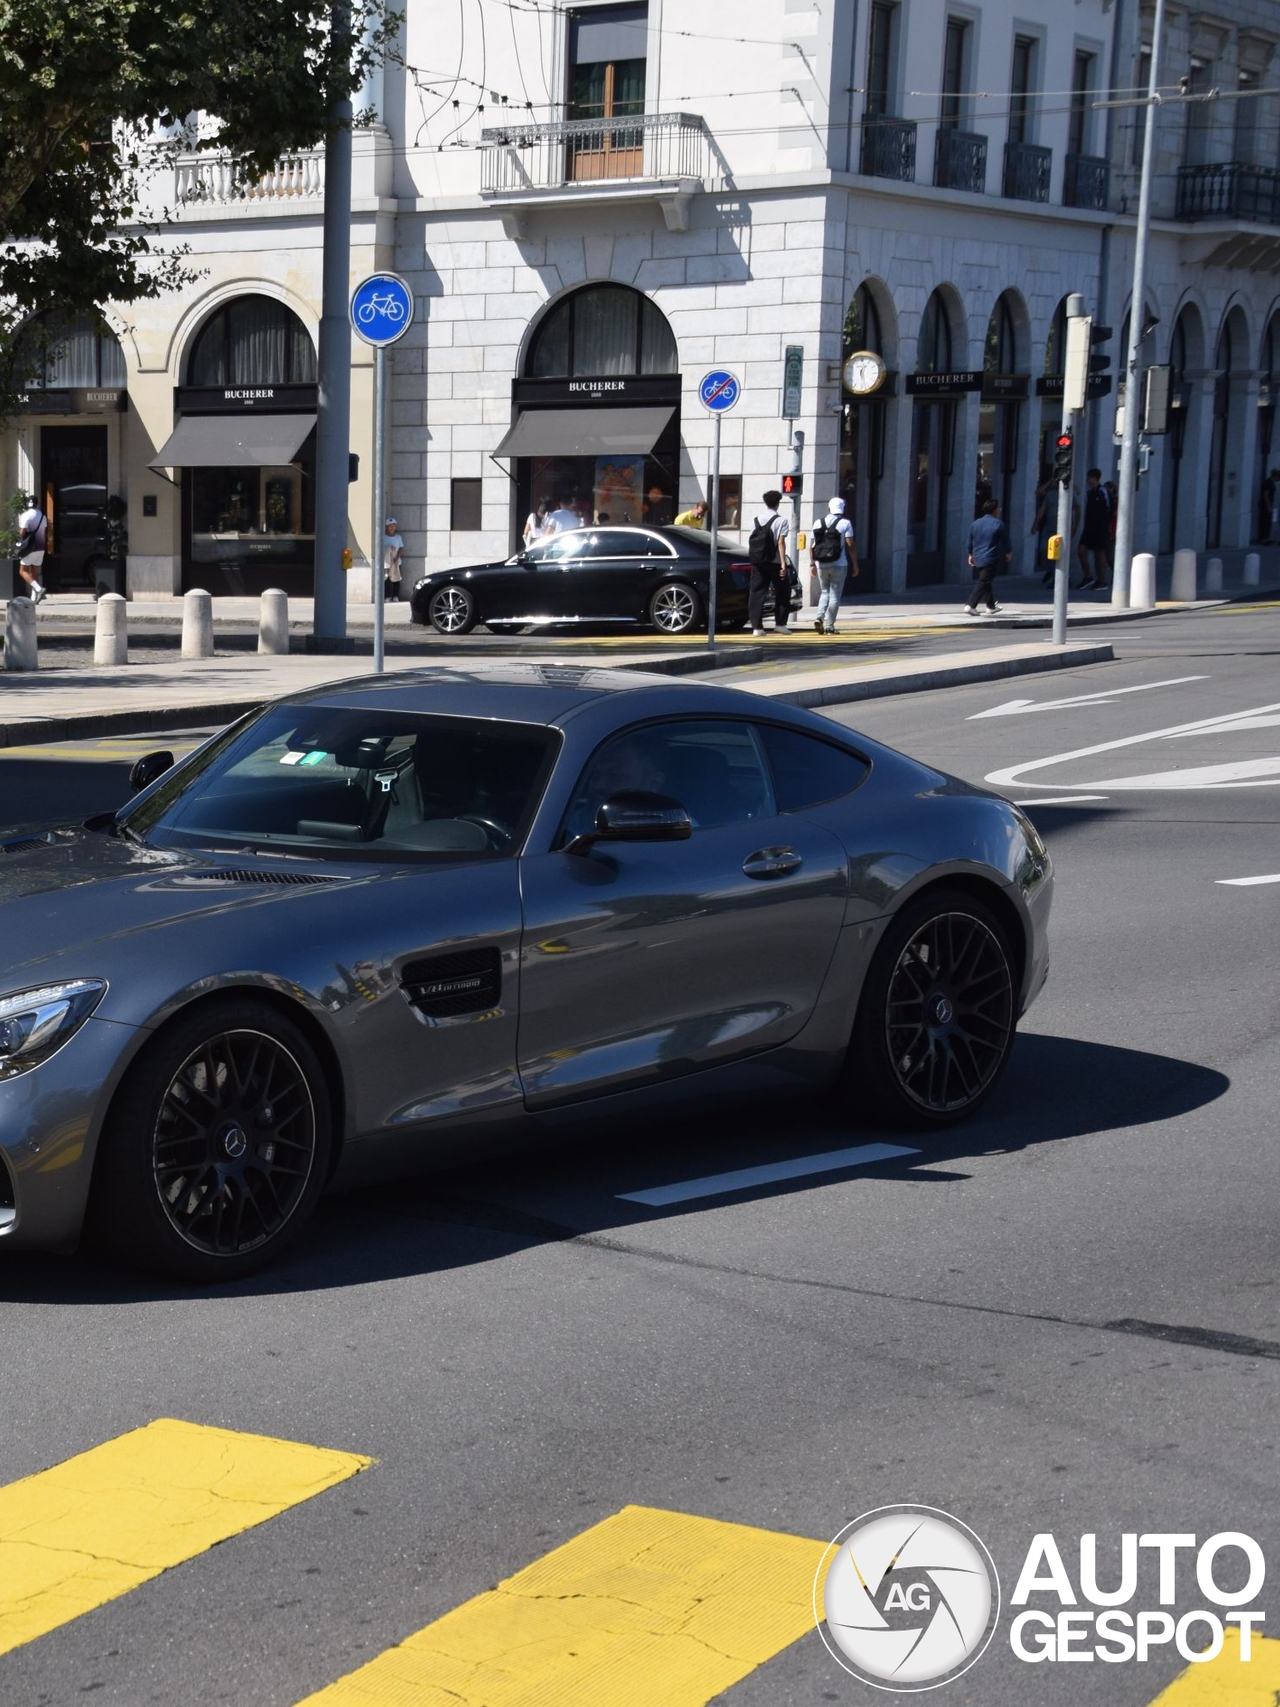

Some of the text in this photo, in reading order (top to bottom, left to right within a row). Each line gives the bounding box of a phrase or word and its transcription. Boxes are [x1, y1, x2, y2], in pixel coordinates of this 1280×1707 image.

[915, 374, 975, 386] BUCHERER
[569, 381, 625, 391] BUCHERER
[86, 392, 118, 401] BUCHERER
[224, 389, 274, 399] BUCHERER
[420, 984, 442, 995] V8
